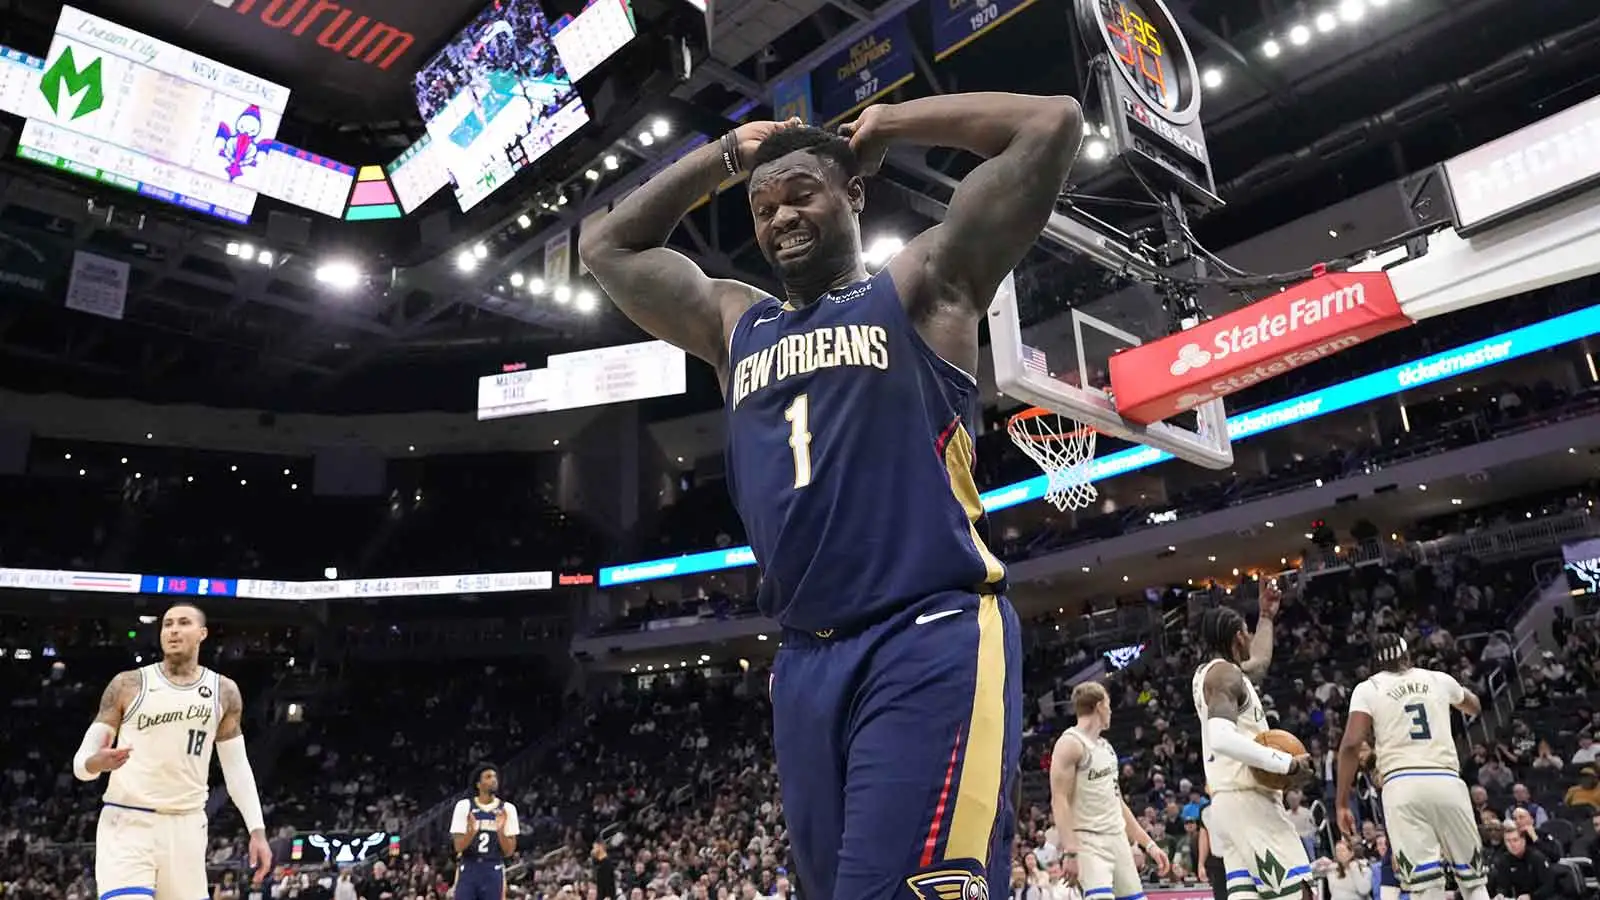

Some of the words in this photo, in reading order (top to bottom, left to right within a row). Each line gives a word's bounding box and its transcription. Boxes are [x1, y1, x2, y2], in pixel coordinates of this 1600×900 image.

[970, 4, 998, 31] 1970
[235, 0, 415, 70] orum
[191, 59, 218, 81] NEW
[855, 77, 879, 102] 1977
[733, 344, 777, 411] NEW
[776, 324, 889, 381] ORLEANS
[1396, 340, 1513, 387] ticketmaster
[784, 394, 813, 489] 1
[1386, 682, 1429, 702] TURNER
[137, 711, 183, 731] Cream
[186, 704, 212, 726] City
[1404, 703, 1432, 740] 3
[187, 729, 207, 756] 18
[478, 832, 490, 853] 2
